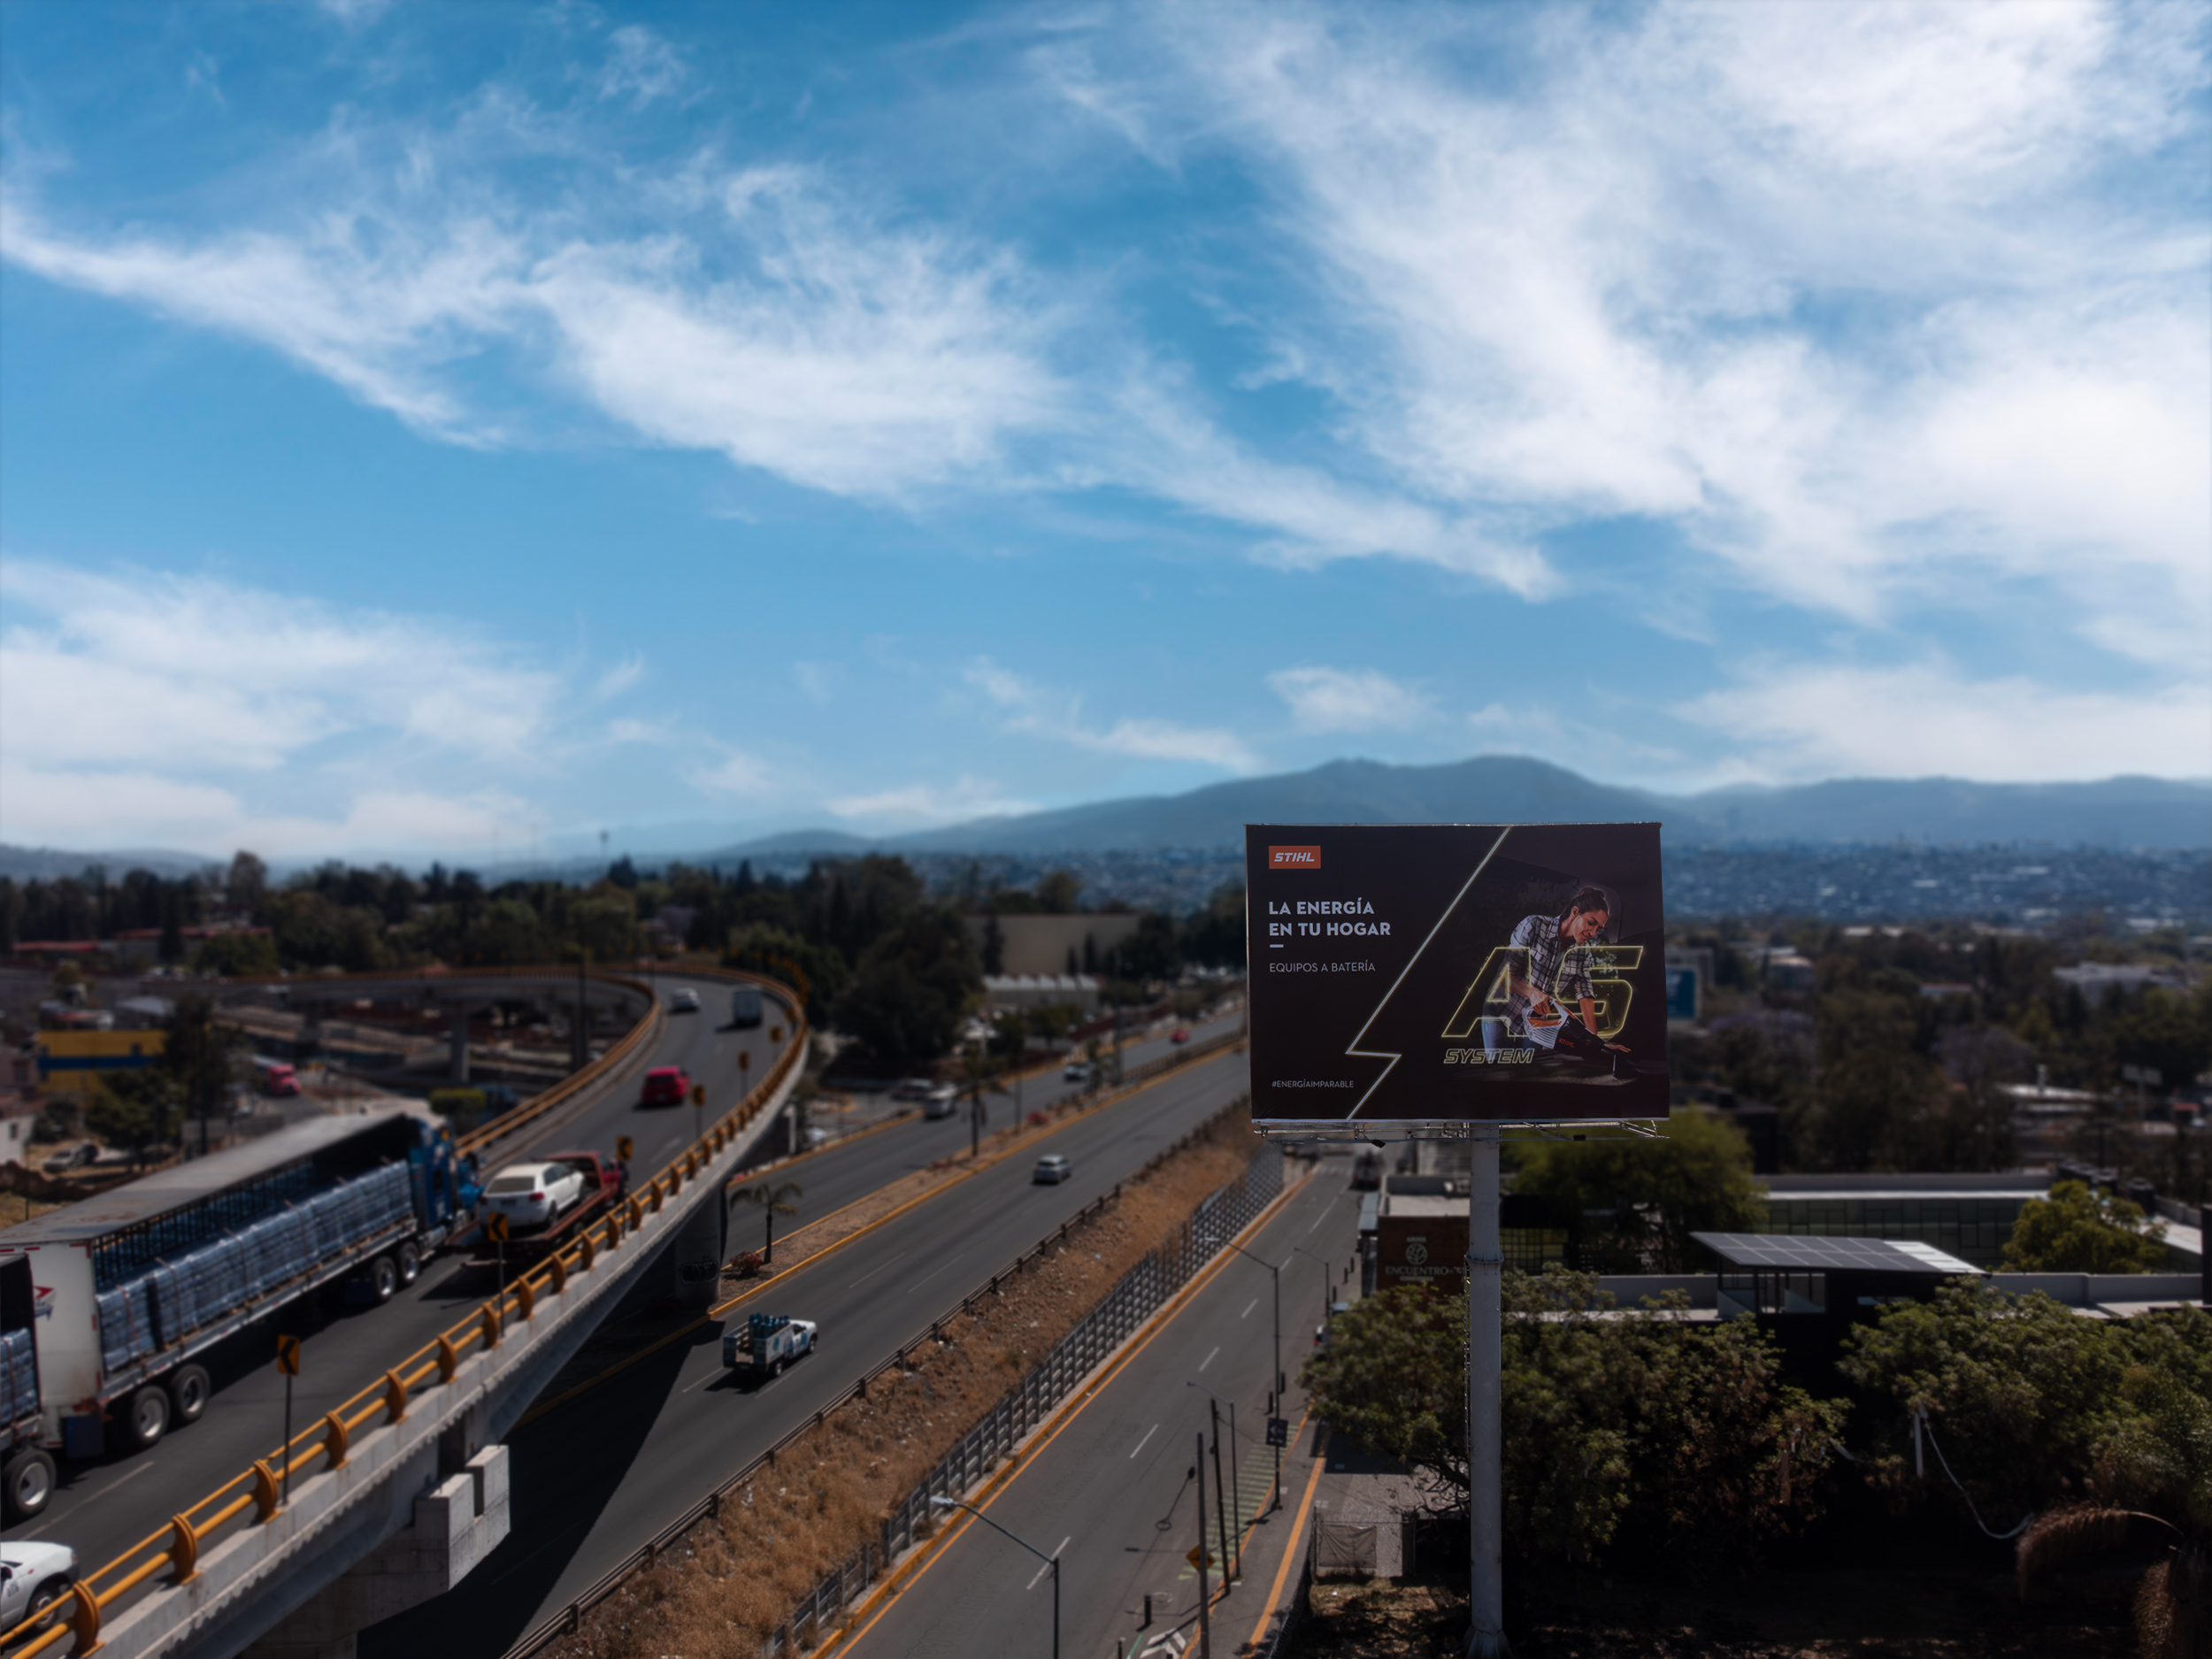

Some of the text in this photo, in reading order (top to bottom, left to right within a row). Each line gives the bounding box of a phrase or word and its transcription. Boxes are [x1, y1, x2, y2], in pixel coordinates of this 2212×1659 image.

[1274, 852, 1315, 863] STIHL
[1269, 896, 1375, 915] LA ENERGÍA
[1269, 922, 1391, 936] EN TU HOGAR
[1269, 959, 1376, 973] EQUIPOS A BATERÍA
[1558, 1037, 1575, 1048] STIHL
[1443, 1048, 1535, 1064] SYSTEM
[1271, 1078, 1355, 1088] #ENERGÍAIMPARABLE
[1385, 1265, 1449, 1276] ENCUENTRO
